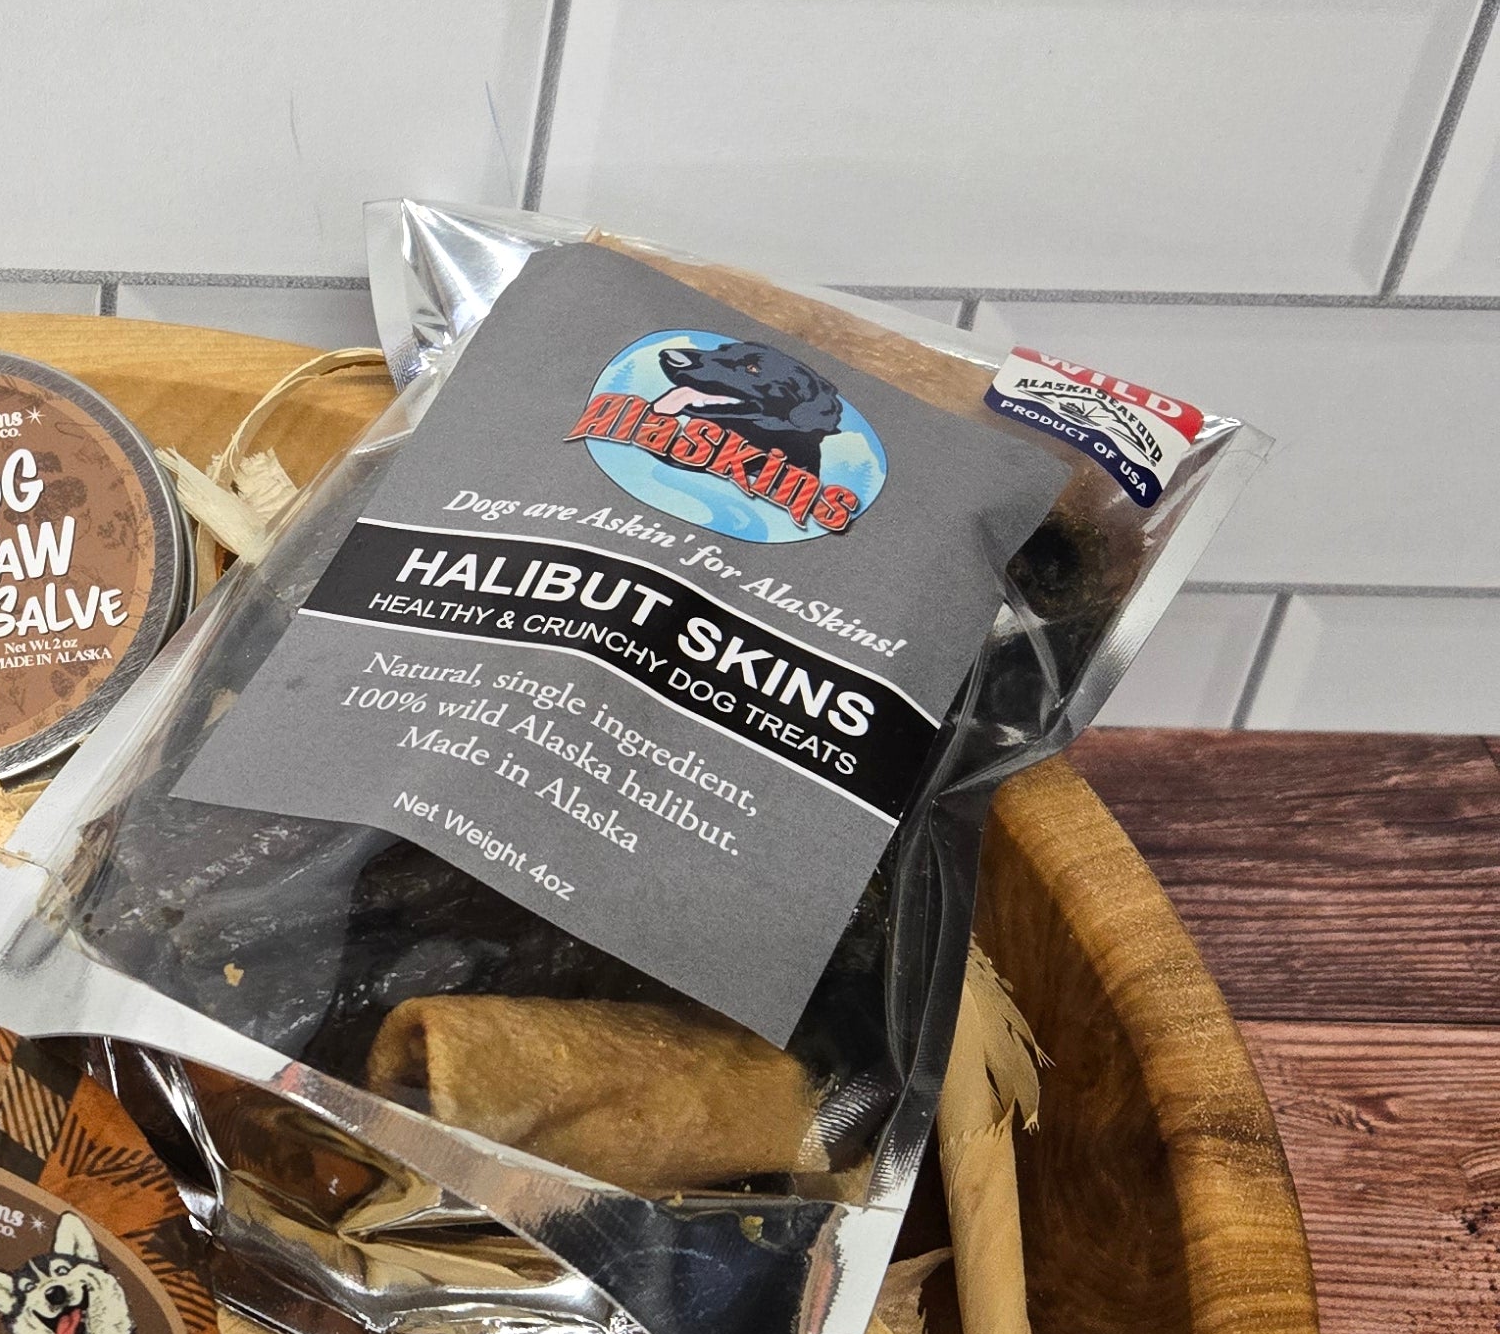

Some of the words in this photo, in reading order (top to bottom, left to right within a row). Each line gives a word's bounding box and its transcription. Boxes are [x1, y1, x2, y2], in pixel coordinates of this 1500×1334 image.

[0, 428, 22, 439] co.
[1014, 378, 1092, 394] ALASKA
[1096, 388, 1163, 465] SEAFOOD
[1038, 354, 1183, 417] WILD
[1000, 399, 1089, 442] PRODUCT
[1093, 440, 1117, 459] OF
[1119, 461, 1147, 496] USA
[443, 489, 517, 517] Dogs
[524, 501, 578, 526] are
[581, 506, 695, 549] Askin'
[681, 543, 742, 580] for
[741, 576, 907, 658] AlaSkins!
[5, 642, 26, 654] Net
[52, 638, 61, 649] 2
[63, 638, 77, 648] oz
[36, 653, 51, 665] IN
[56, 647, 112, 663] ALASKA
[369, 592, 500, 627] HEALTHY
[496, 611, 516, 630] &
[523, 615, 668, 673] CRUNCHY
[668, 668, 734, 713] DOG
[743, 702, 857, 775] TREATS
[396, 547, 675, 627] HALIBUT
[678, 617, 875, 738] SKINS
[340, 685, 426, 714] 100%
[438, 698, 503, 728] wild
[507, 713, 613, 781] Alaska
[617, 768, 739, 856] halibut.
[364, 652, 482, 687] Natural,
[493, 671, 586, 715] single
[592, 703, 759, 818] ingredient,
[397, 726, 490, 766] Made
[495, 753, 531, 788] in
[535, 778, 638, 853] Alaska
[394, 791, 440, 822] Net
[445, 809, 527, 873] Weight
[528, 864, 575, 900] 4oz
